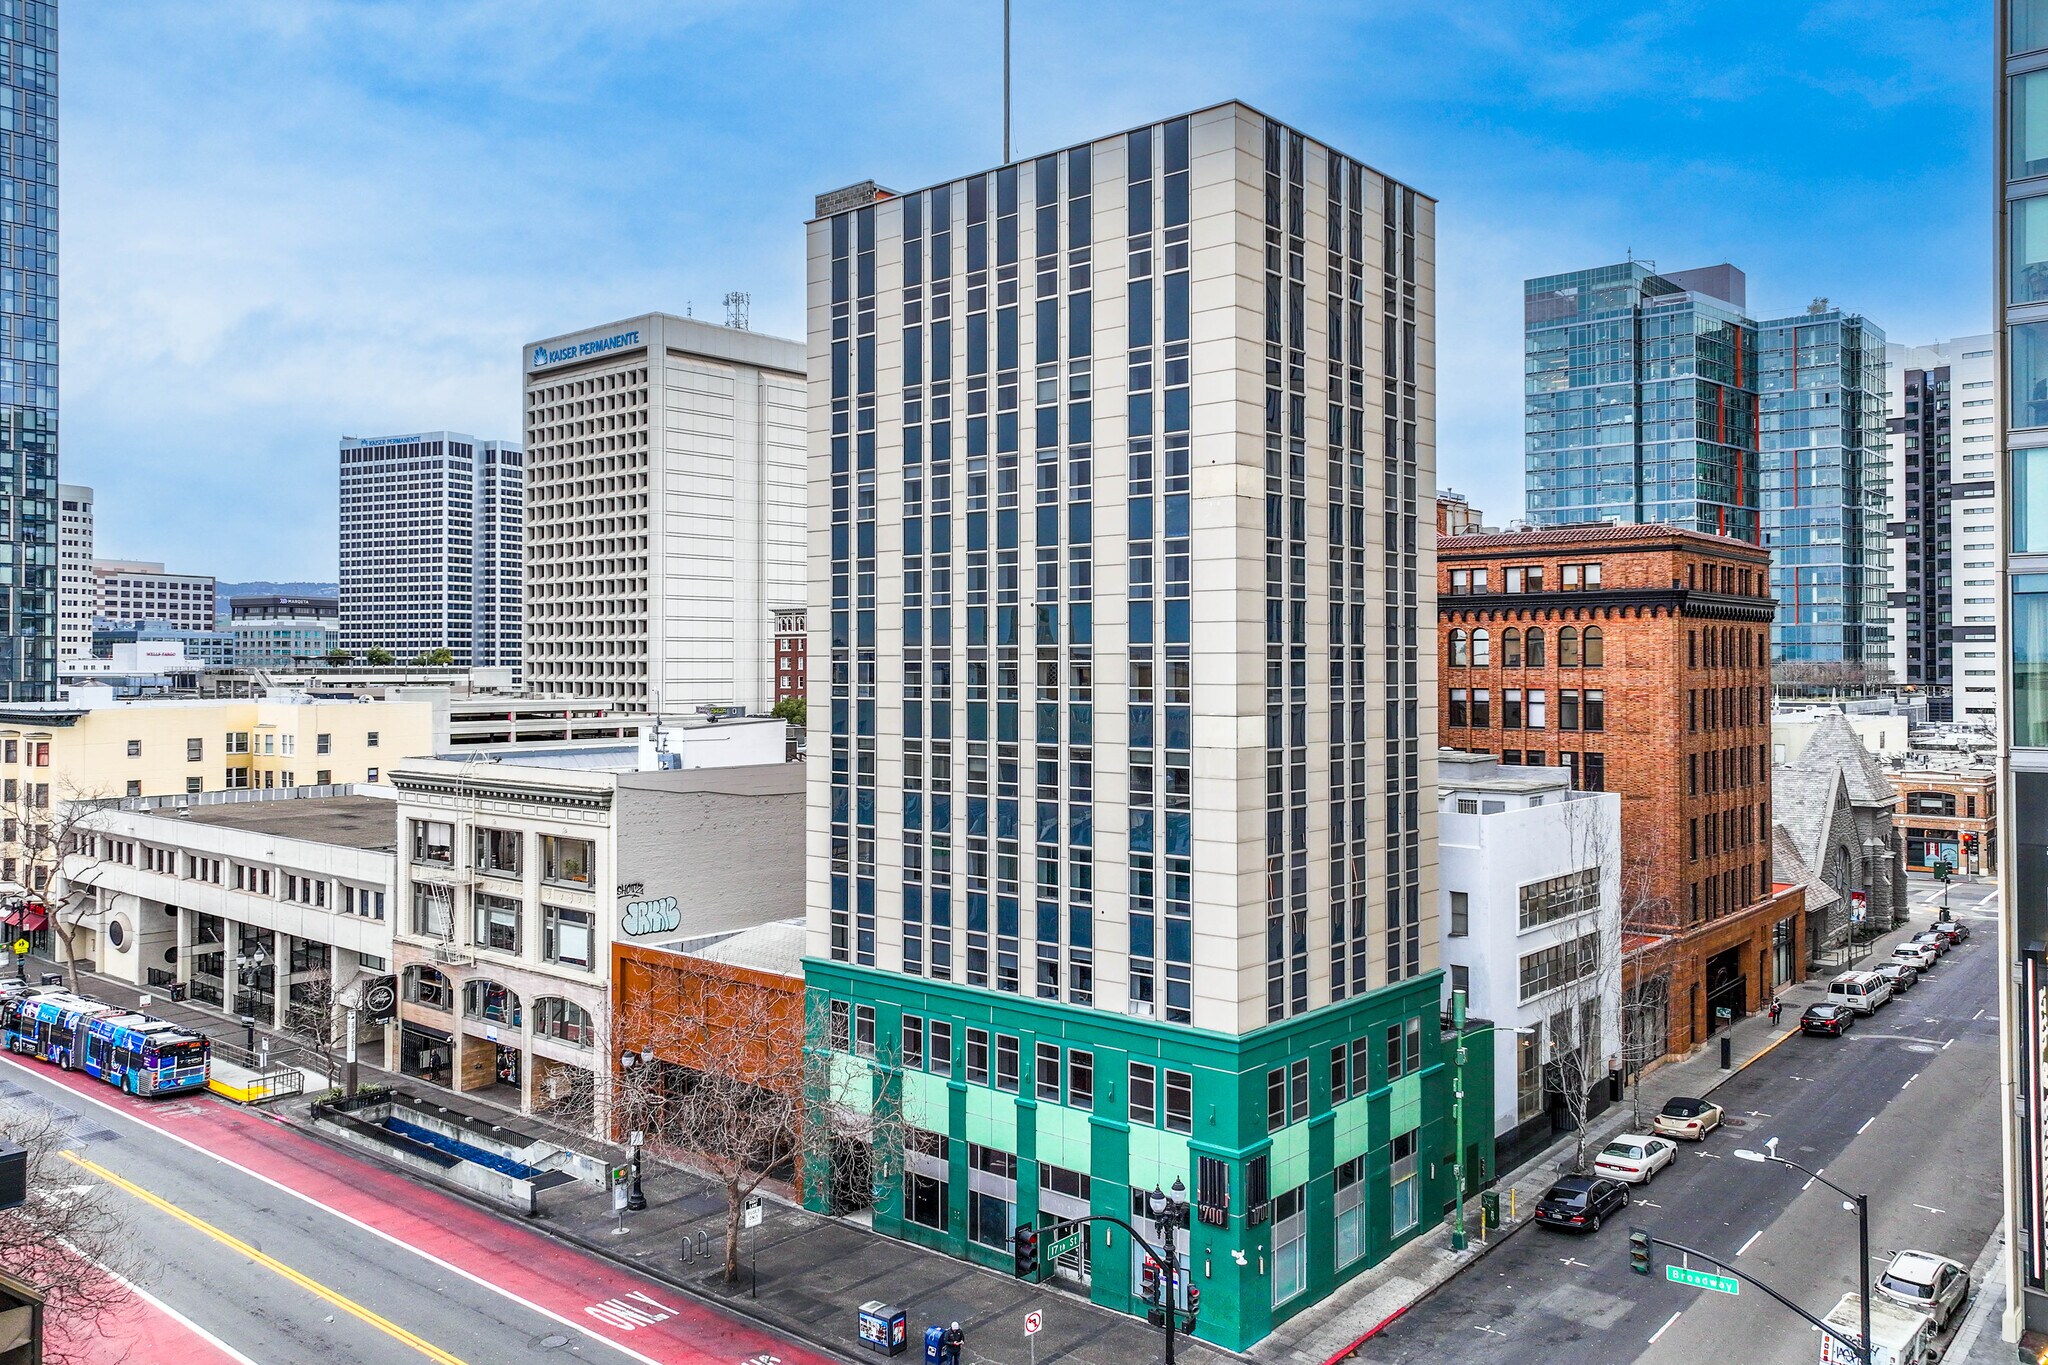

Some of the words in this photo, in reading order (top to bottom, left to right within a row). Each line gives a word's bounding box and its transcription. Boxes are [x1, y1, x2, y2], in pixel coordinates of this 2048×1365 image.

[549, 346, 578, 363] KAISER
[580, 331, 640, 357] PERMANENTE
[368, 439, 387, 447] KAISER
[387, 436, 421, 445] PERMANENTE
[1050, 1243, 1066, 1256] 17th
[1069, 1236, 1078, 1247] St
[1672, 1269, 1732, 1293] Broadway
[584, 1291, 680, 1331] ONLY
